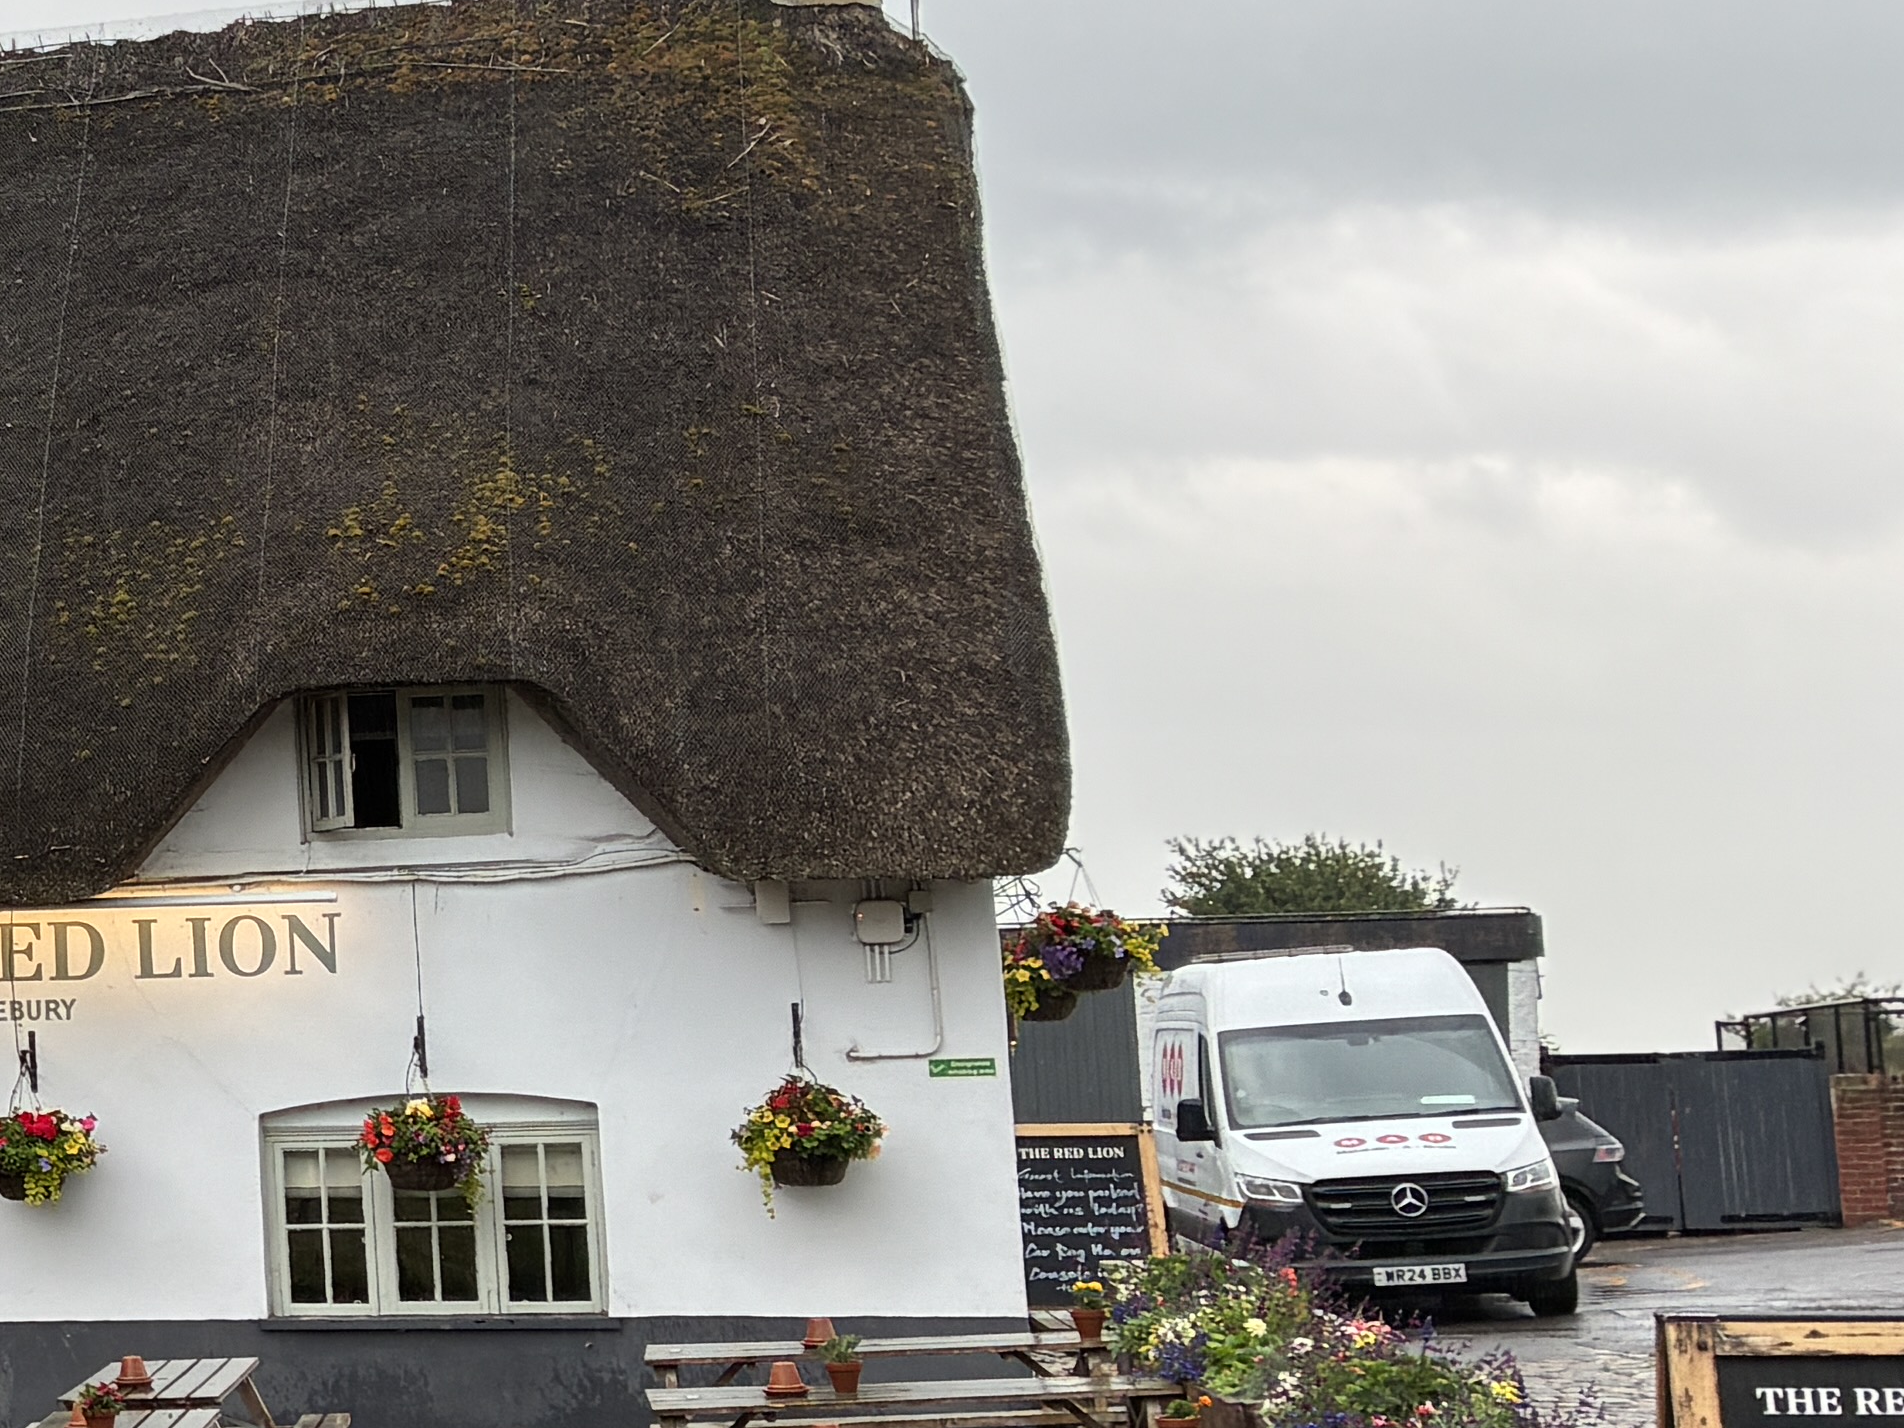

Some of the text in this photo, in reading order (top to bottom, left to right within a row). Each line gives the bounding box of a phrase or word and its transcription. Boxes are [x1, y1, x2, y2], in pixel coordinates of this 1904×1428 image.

[132, 912, 342, 980] LION
[1018, 1146, 1125, 1160] THE RED LION
[1053, 1190, 1085, 1208] you
[1020, 1203, 1060, 1218] with
[1063, 1207, 1084, 1216] us
[1385, 1266, 1462, 1283] WR24 BBX
[1755, 1387, 1842, 1416] THE
